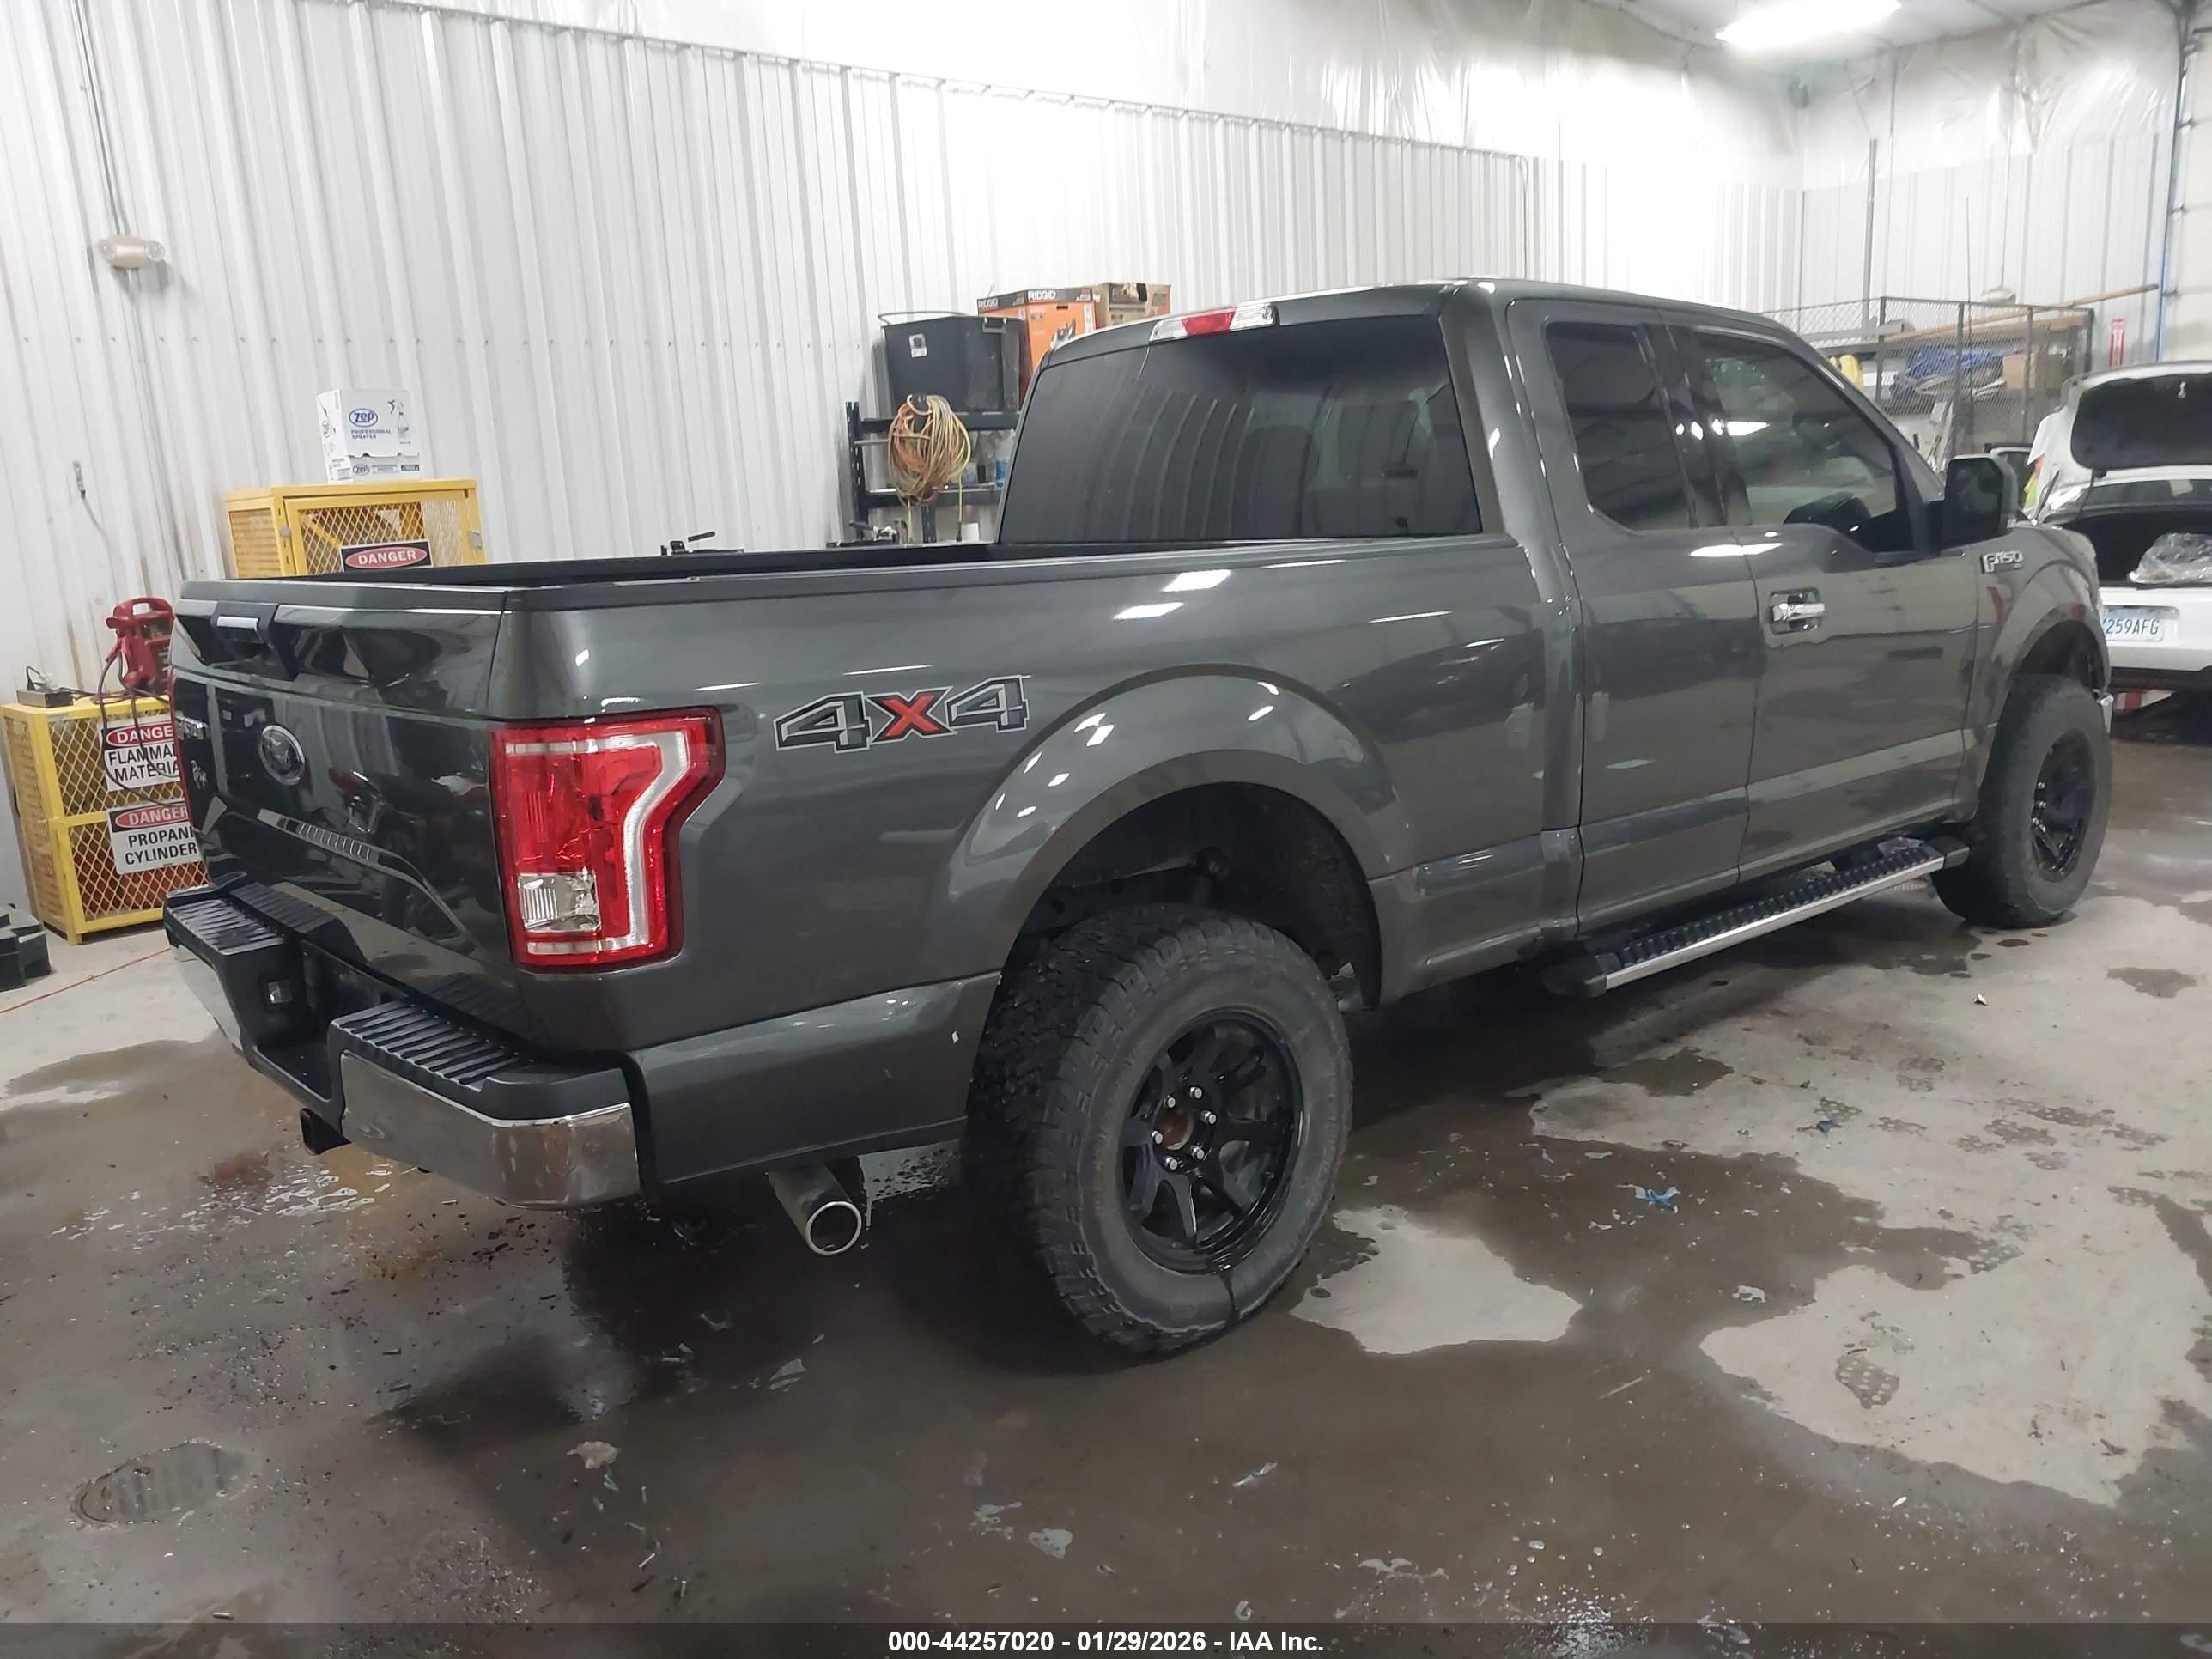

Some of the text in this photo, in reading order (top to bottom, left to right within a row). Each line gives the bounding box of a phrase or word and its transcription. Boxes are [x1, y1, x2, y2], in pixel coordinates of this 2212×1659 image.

[1028, 290, 1057, 301] RIDGID
[357, 550, 416, 565] DANGER
[107, 743, 175, 766] FLAMMA
[128, 807, 188, 825] DANGER
